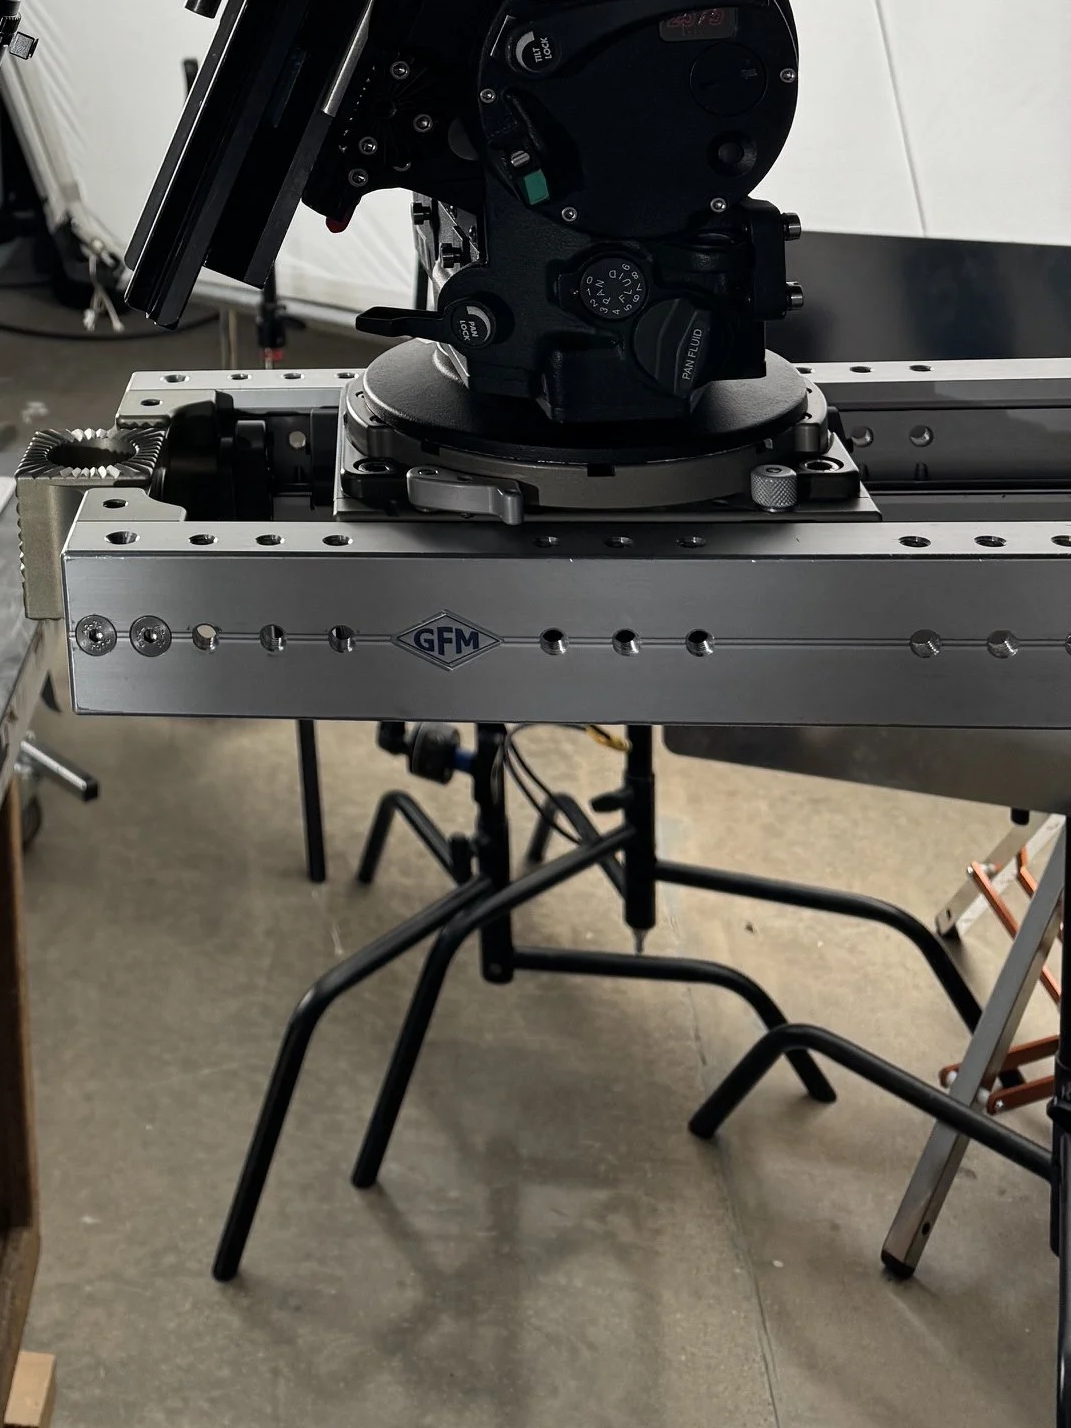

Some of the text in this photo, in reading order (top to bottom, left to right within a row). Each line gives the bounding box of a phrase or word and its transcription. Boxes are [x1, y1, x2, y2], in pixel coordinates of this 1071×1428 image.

[532, 47, 543, 63] TILT
[540, 37, 553, 59] LOCK
[587, 276, 593, 284] 0
[590, 299, 598, 307] 2
[596, 280, 611, 304] PAN
[458, 318, 472, 343] LOCK
[467, 319, 479, 339] PAN
[681, 327, 704, 381] PAN FLUID
[413, 626, 480, 656] GFM
